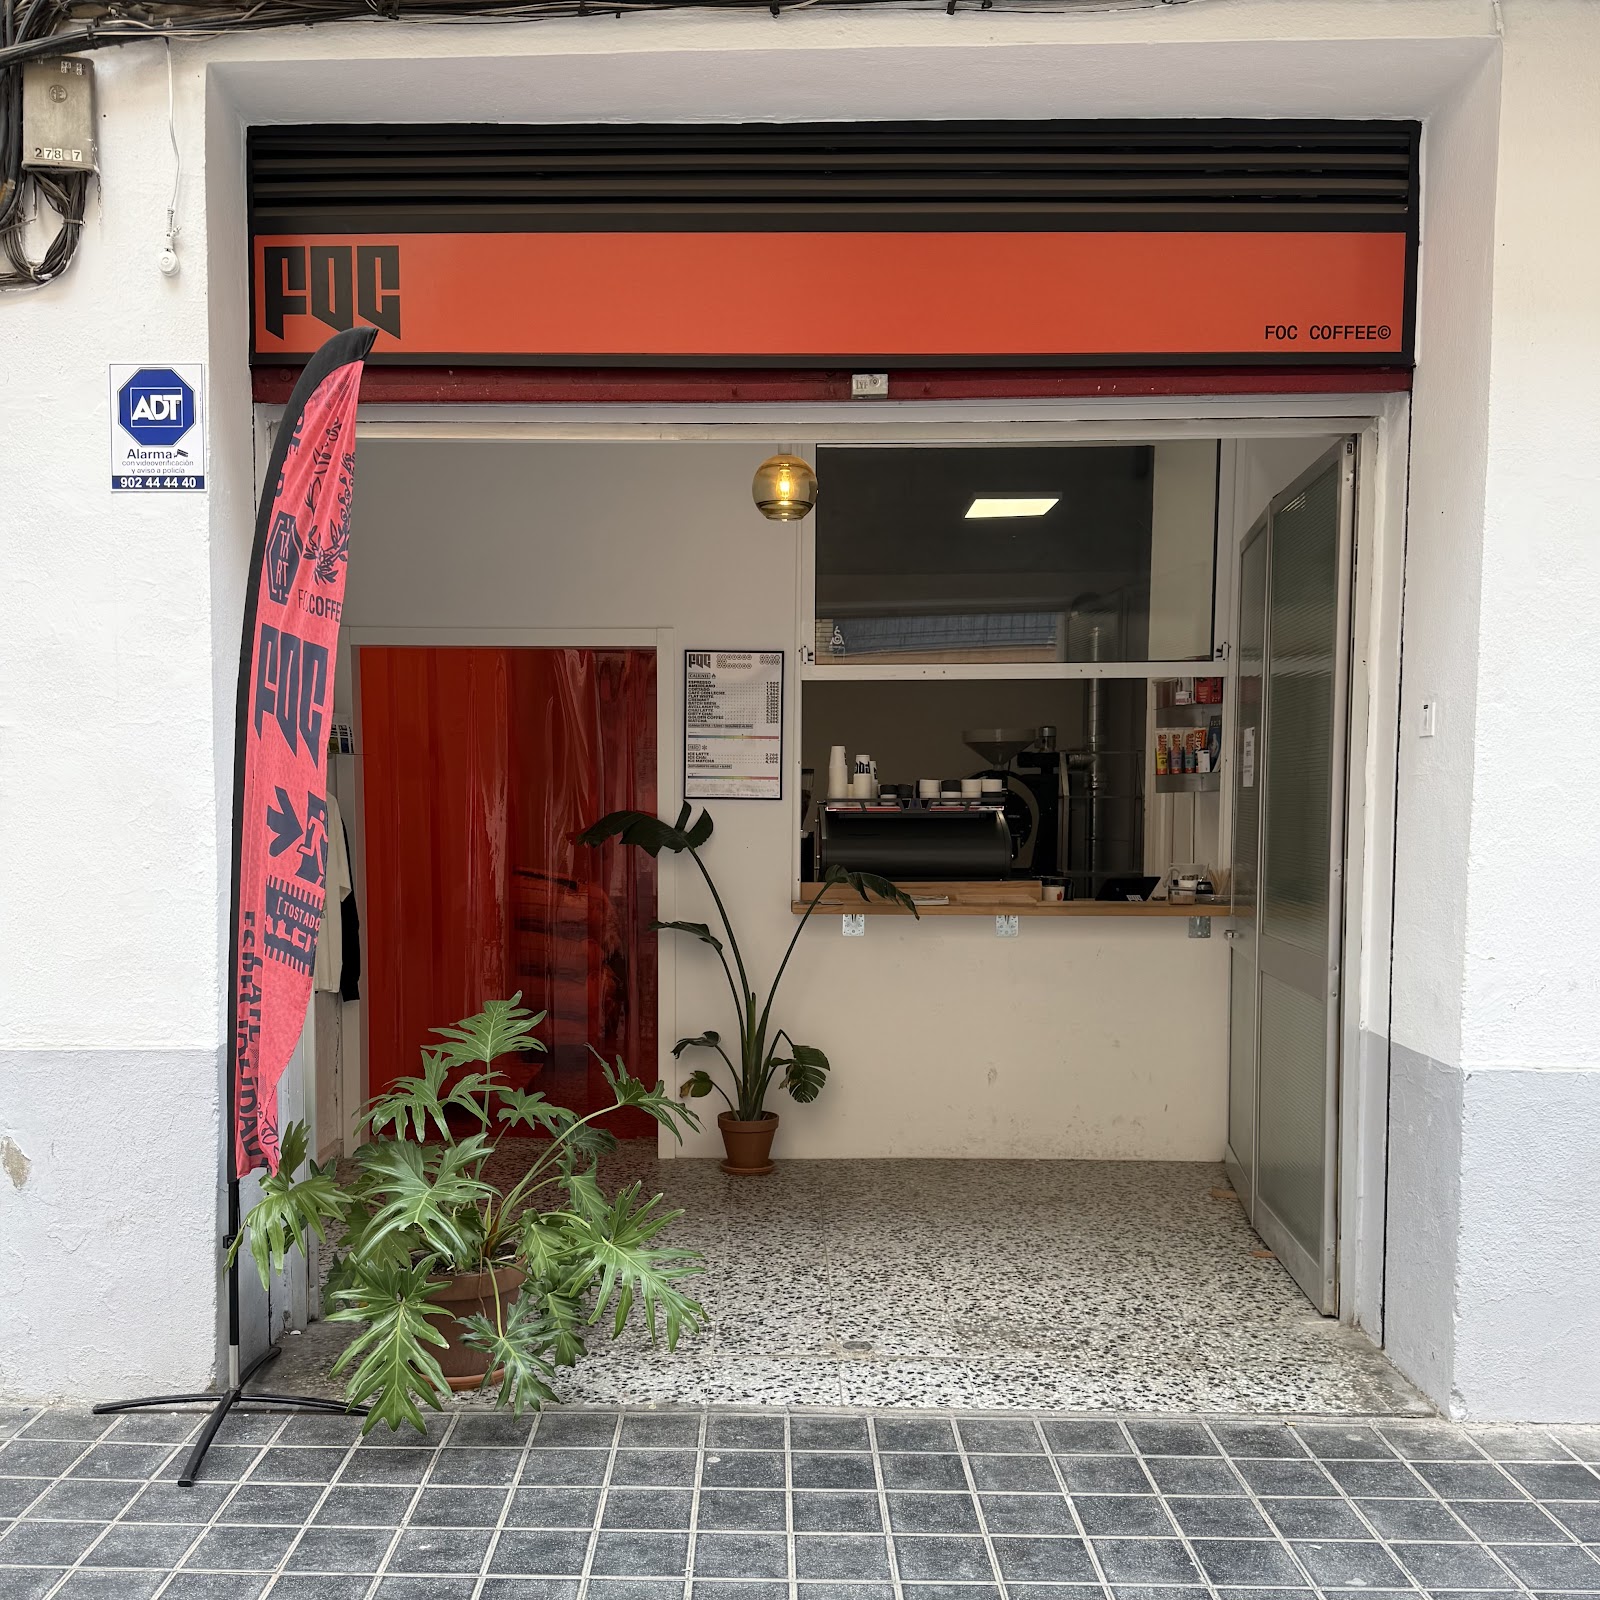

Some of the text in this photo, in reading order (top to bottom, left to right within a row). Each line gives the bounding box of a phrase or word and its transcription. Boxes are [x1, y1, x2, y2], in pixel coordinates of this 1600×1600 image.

[264, 245, 401, 341] FOC
[1265, 325, 1298, 340] FOC
[131, 394, 182, 420] ADT
[127, 449, 172, 460] Alarma
[135, 459, 194, 467] videoverificación
[120, 477, 197, 488] 902 44 44 40
[254, 622, 329, 770] FOC
